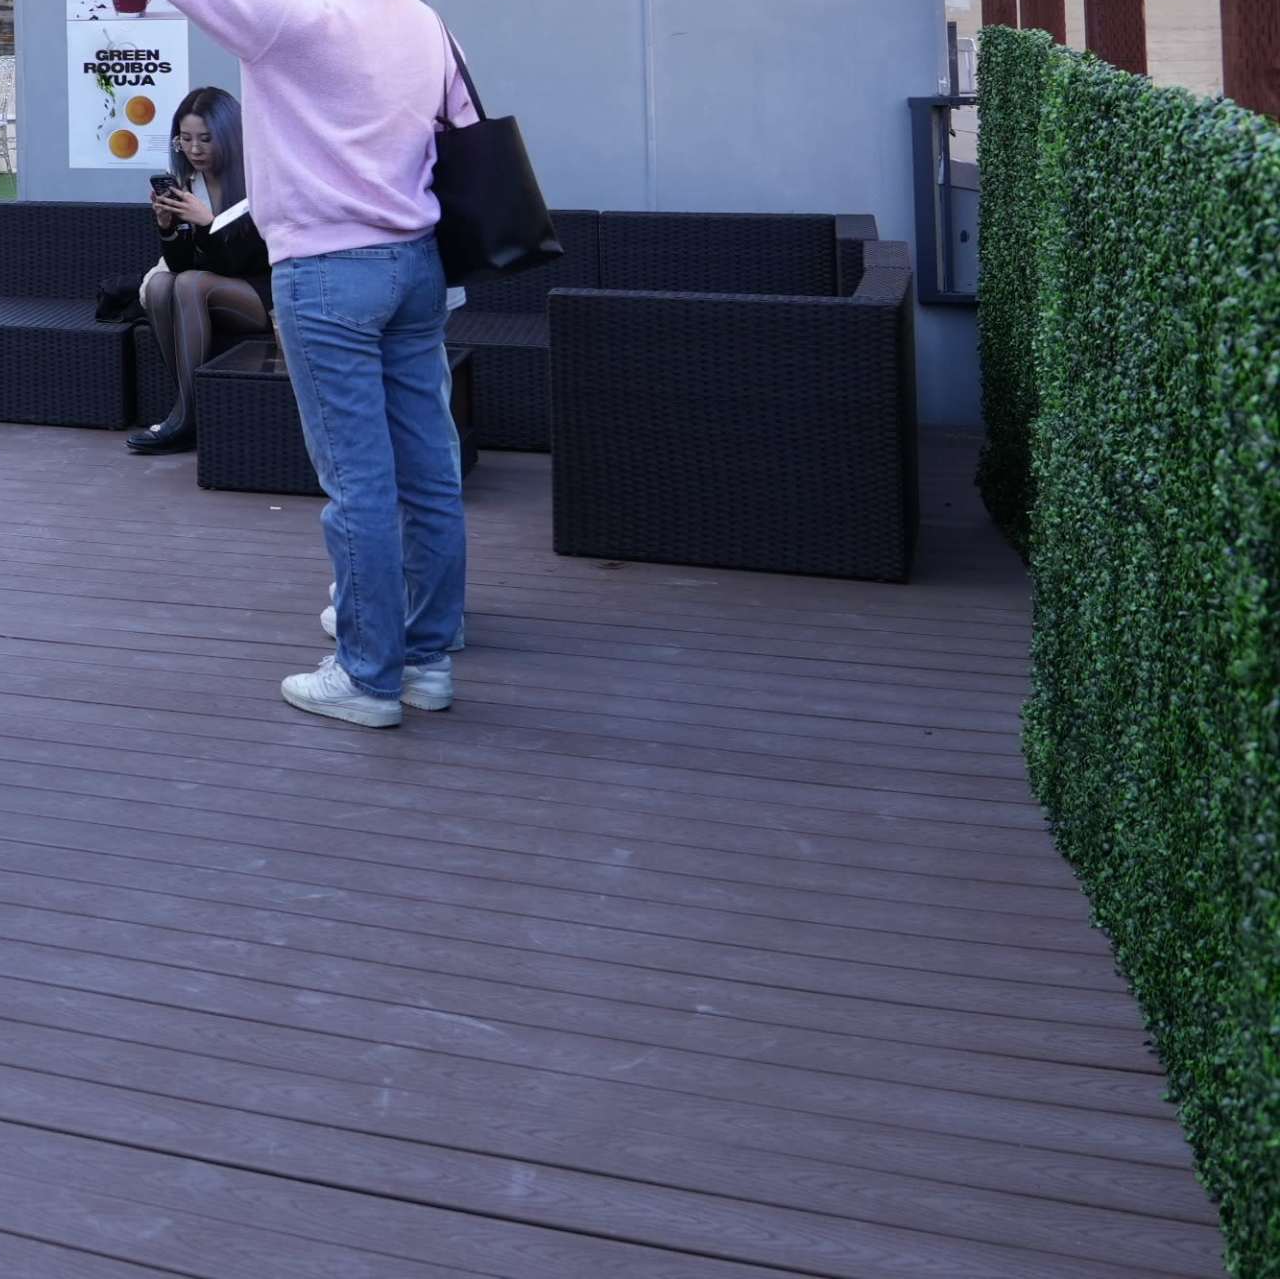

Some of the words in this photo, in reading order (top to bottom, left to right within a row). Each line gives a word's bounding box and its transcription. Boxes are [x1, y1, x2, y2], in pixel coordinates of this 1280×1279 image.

[95, 49, 160, 61] GREEN
[83, 62, 172, 73] ROOIBOS
[101, 75, 155, 86] YUJA
